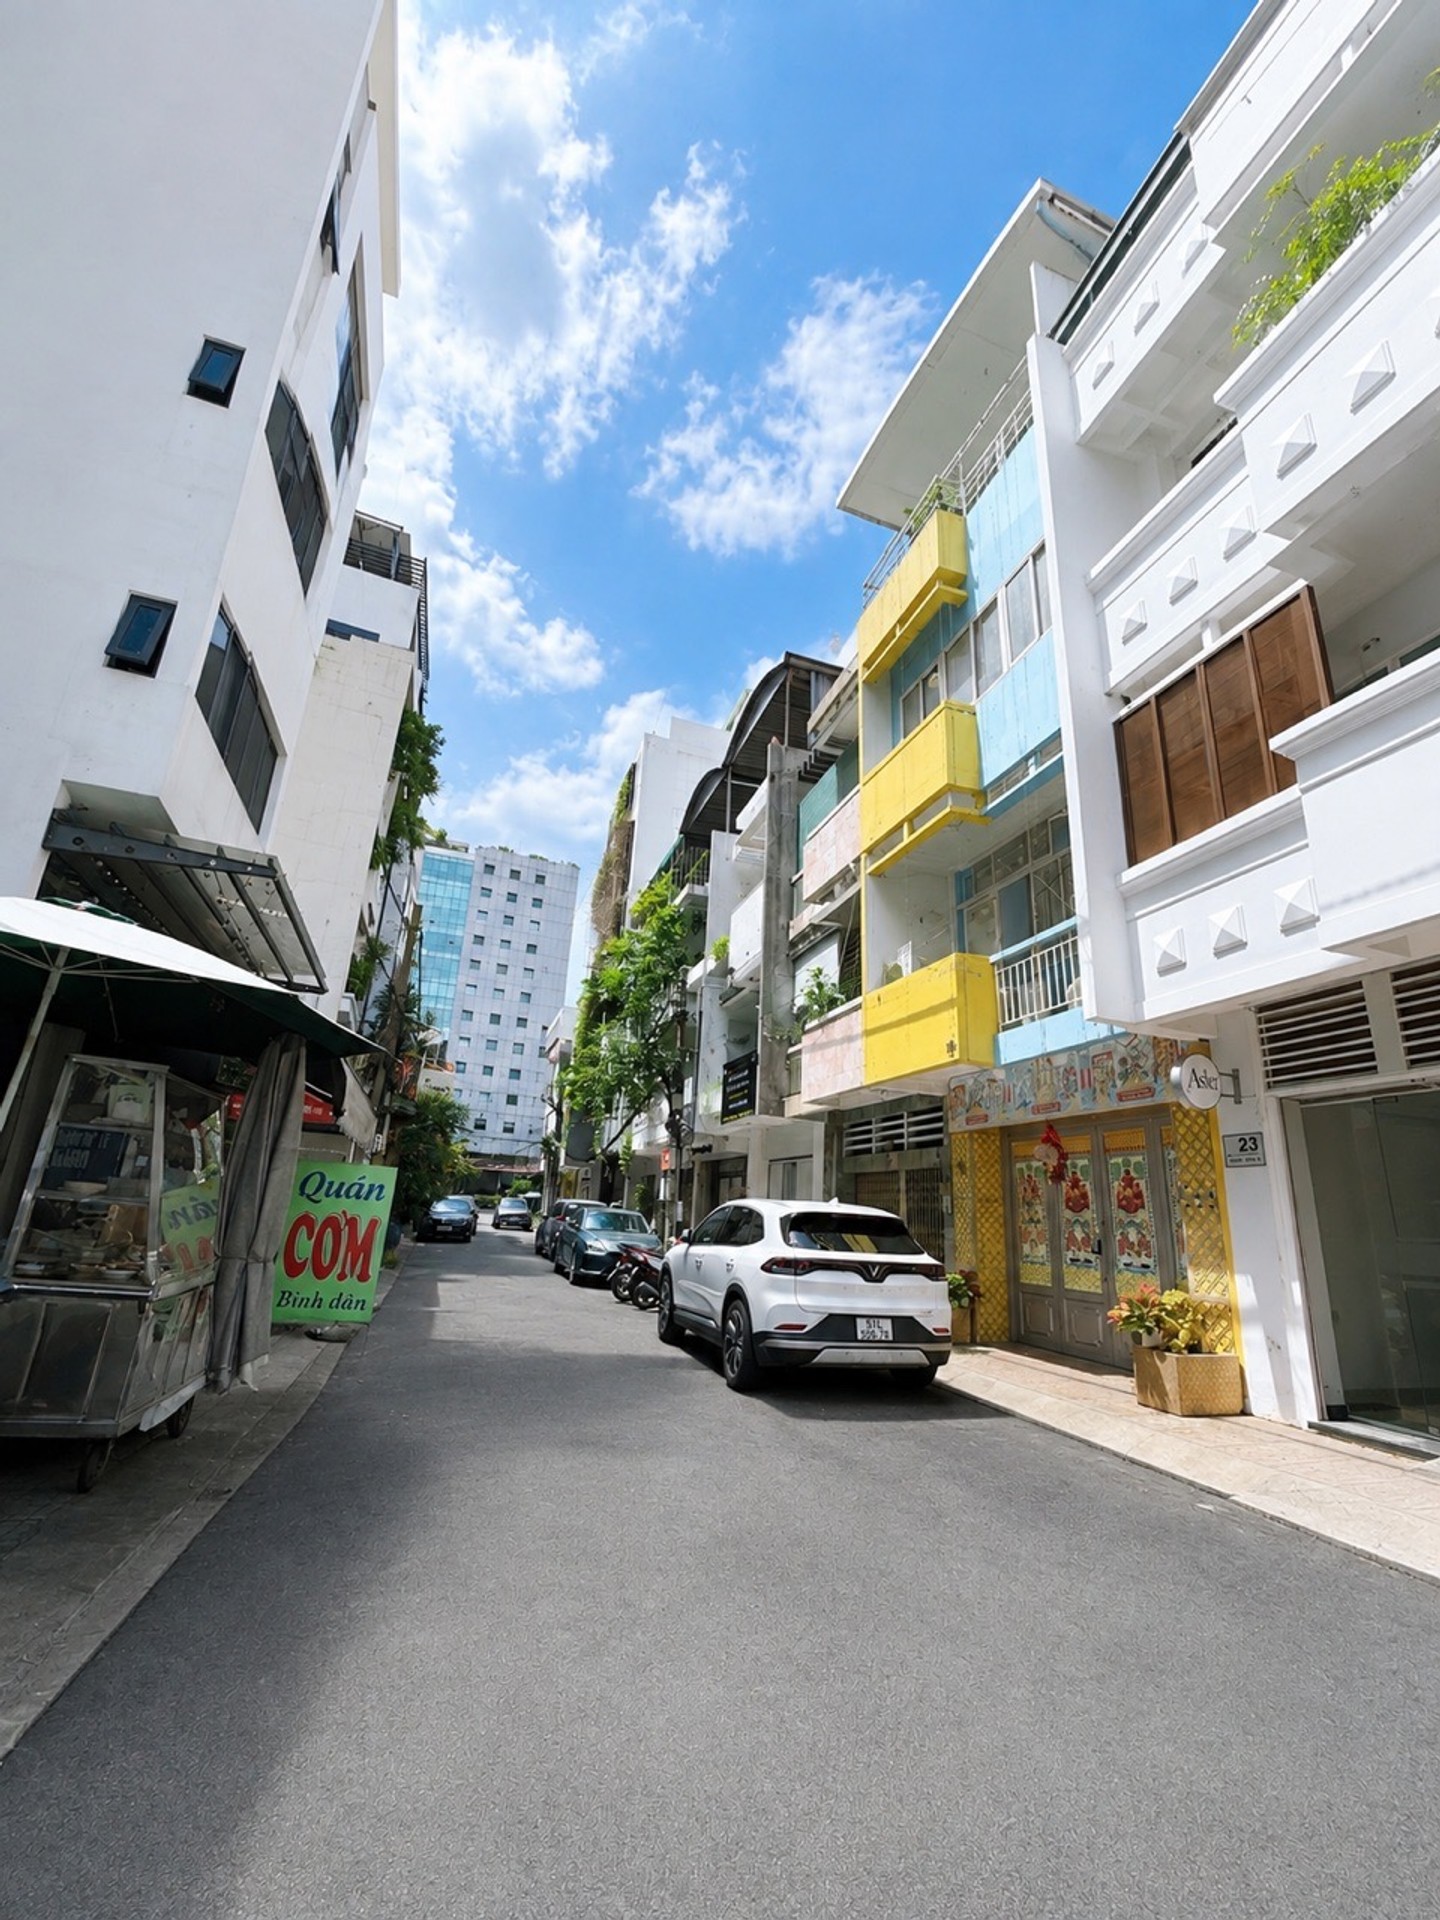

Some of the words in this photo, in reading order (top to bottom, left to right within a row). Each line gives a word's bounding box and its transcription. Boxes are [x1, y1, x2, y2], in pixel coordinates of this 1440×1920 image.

[1238, 1136, 1259, 1152] 23
[298, 1171, 385, 1204] Quán
[283, 1209, 382, 1283] CƠM
[328, 1292, 366, 1311] dân
